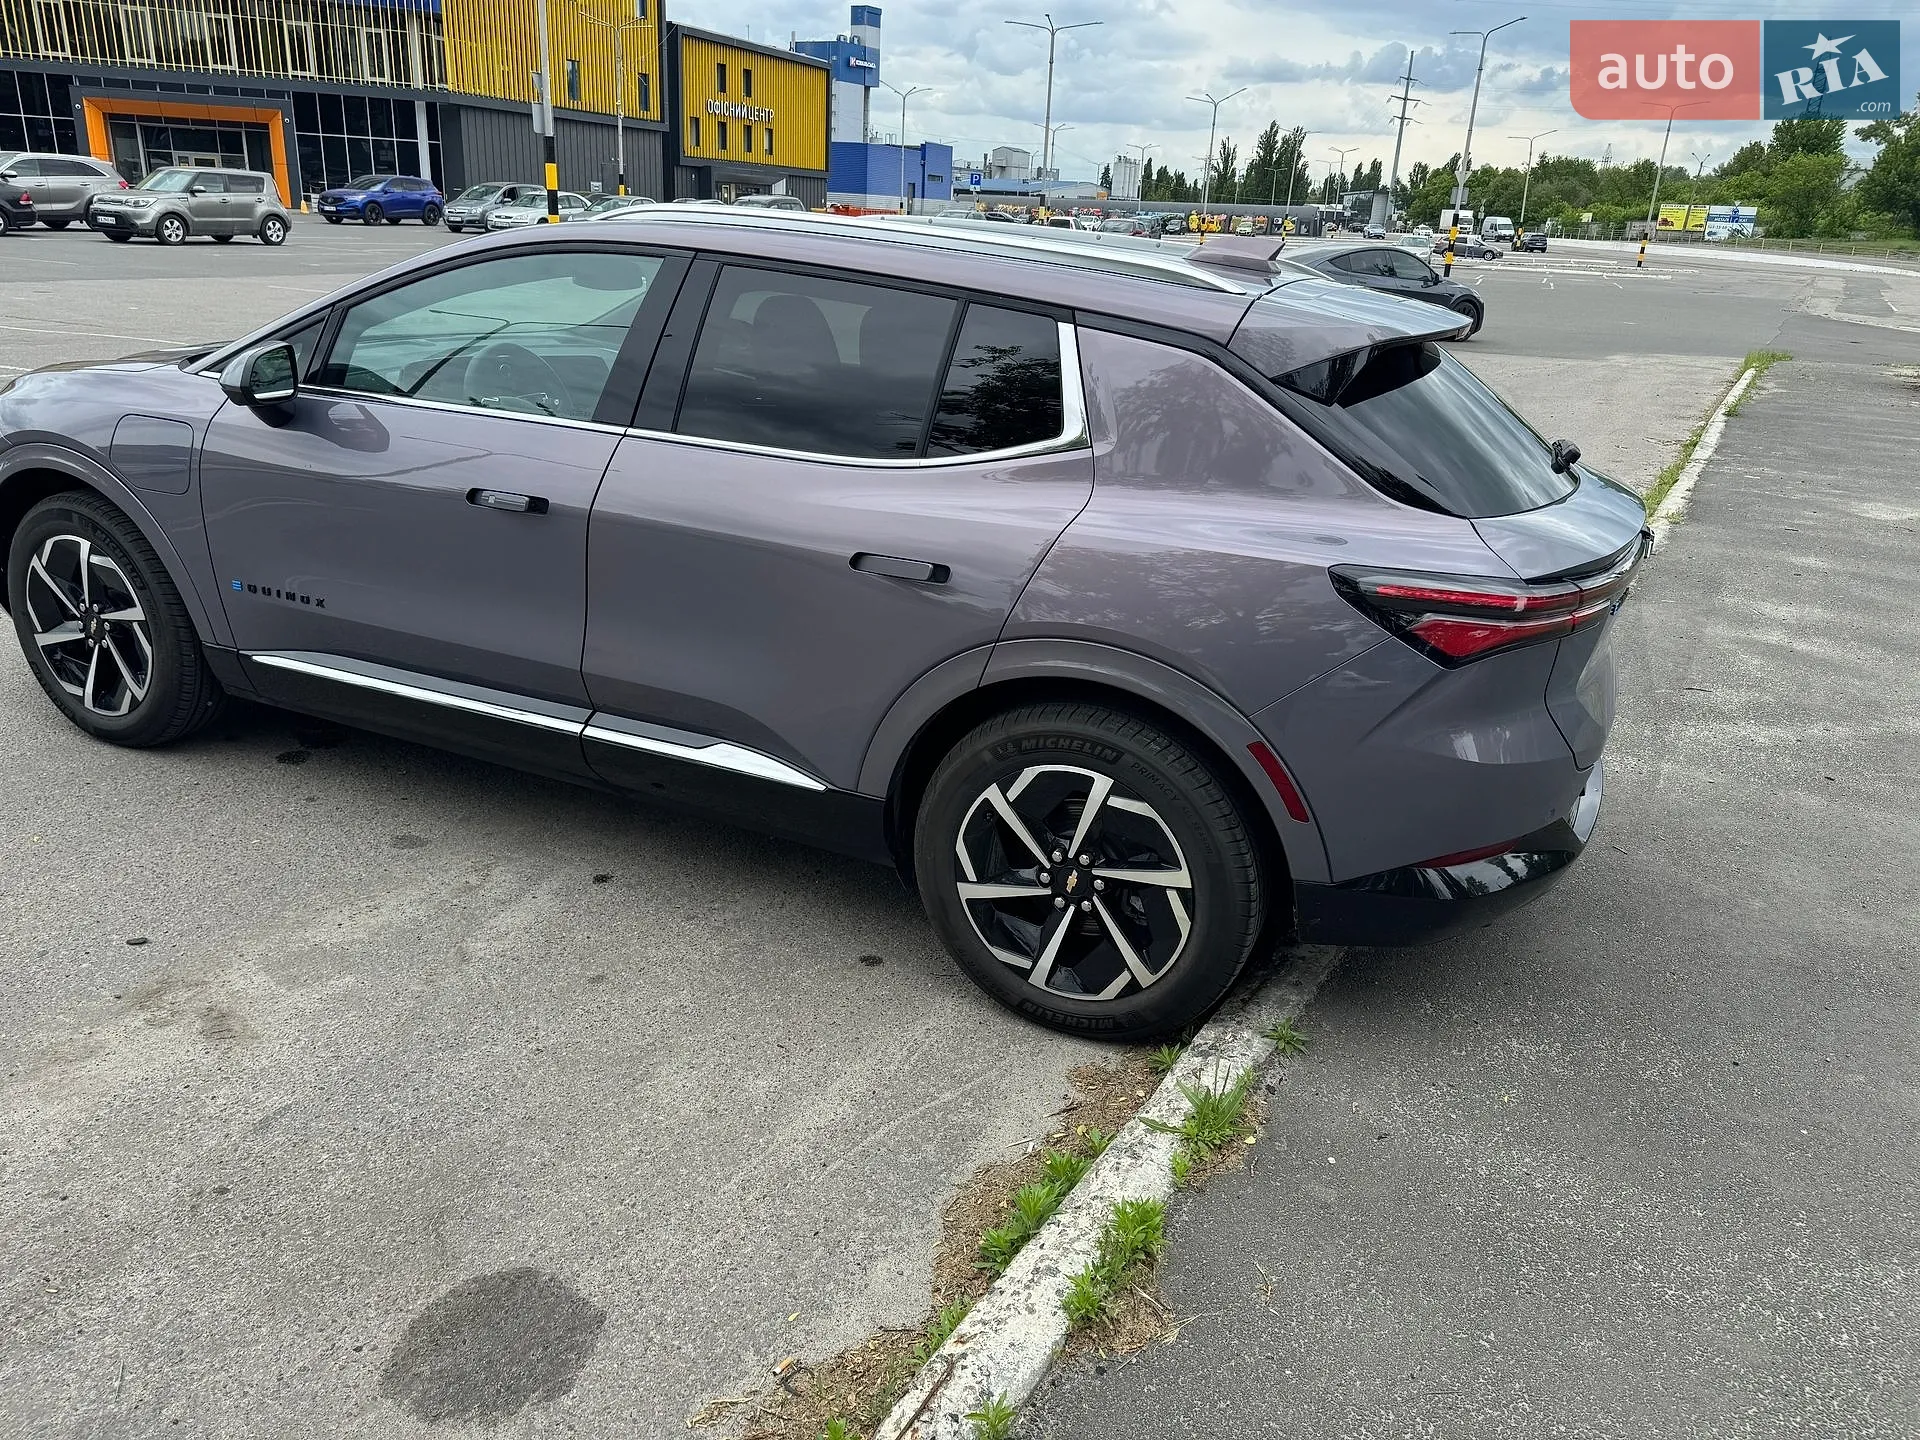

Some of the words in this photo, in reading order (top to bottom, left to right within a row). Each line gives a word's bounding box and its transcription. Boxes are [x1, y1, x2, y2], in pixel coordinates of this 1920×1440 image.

[707, 98, 748, 119] ОФІСНИЙ
[748, 105, 775, 122] ЦЕНТР
[231, 579, 326, 609] EQUINOX
[1021, 735, 1118, 762] MICHELIN
[1131, 761, 1180, 801] PRIMACY
[1021, 1002, 1115, 1029] MICHELIN
